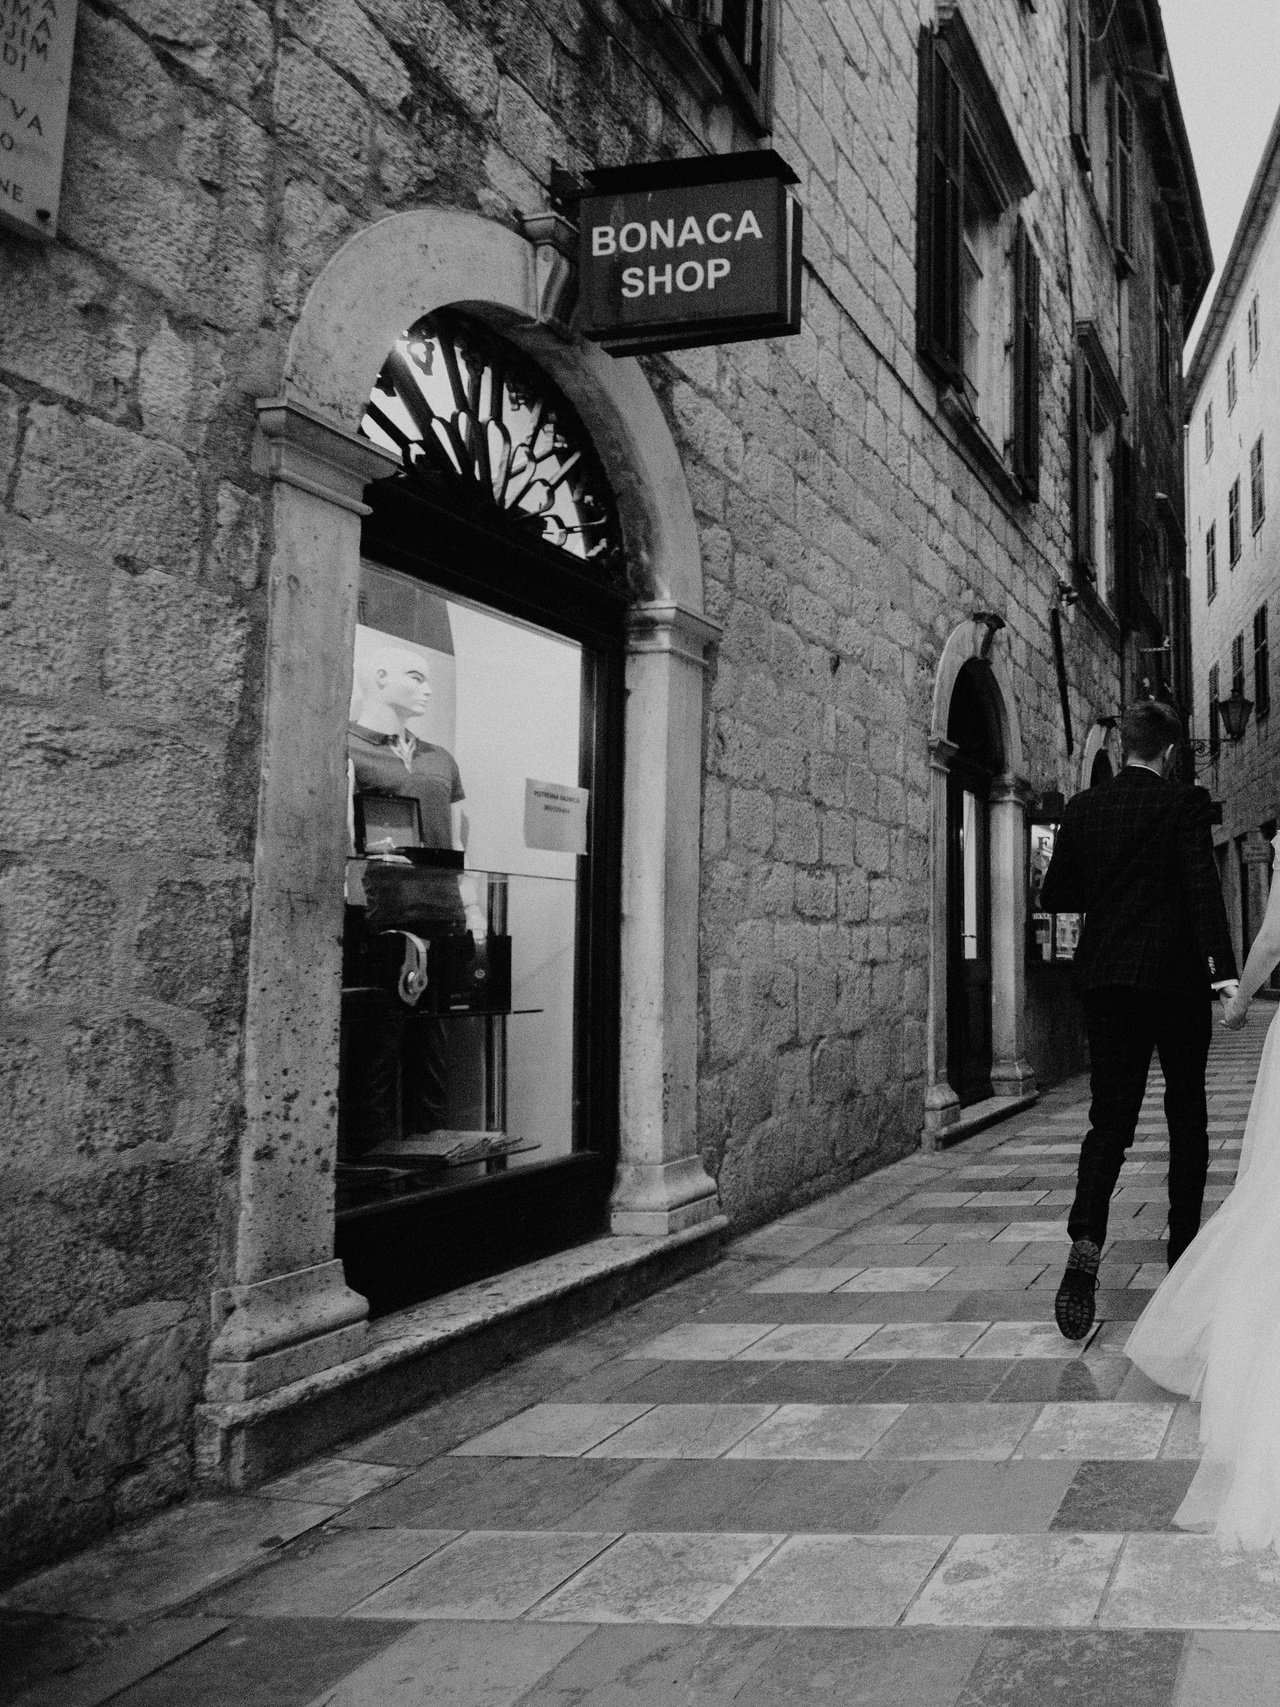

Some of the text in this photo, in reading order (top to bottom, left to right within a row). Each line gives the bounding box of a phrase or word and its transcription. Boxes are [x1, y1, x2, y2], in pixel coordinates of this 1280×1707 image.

[0, 91, 43, 136] VA
[592, 210, 763, 256] BONACA
[621, 258, 731, 298] SHOP
